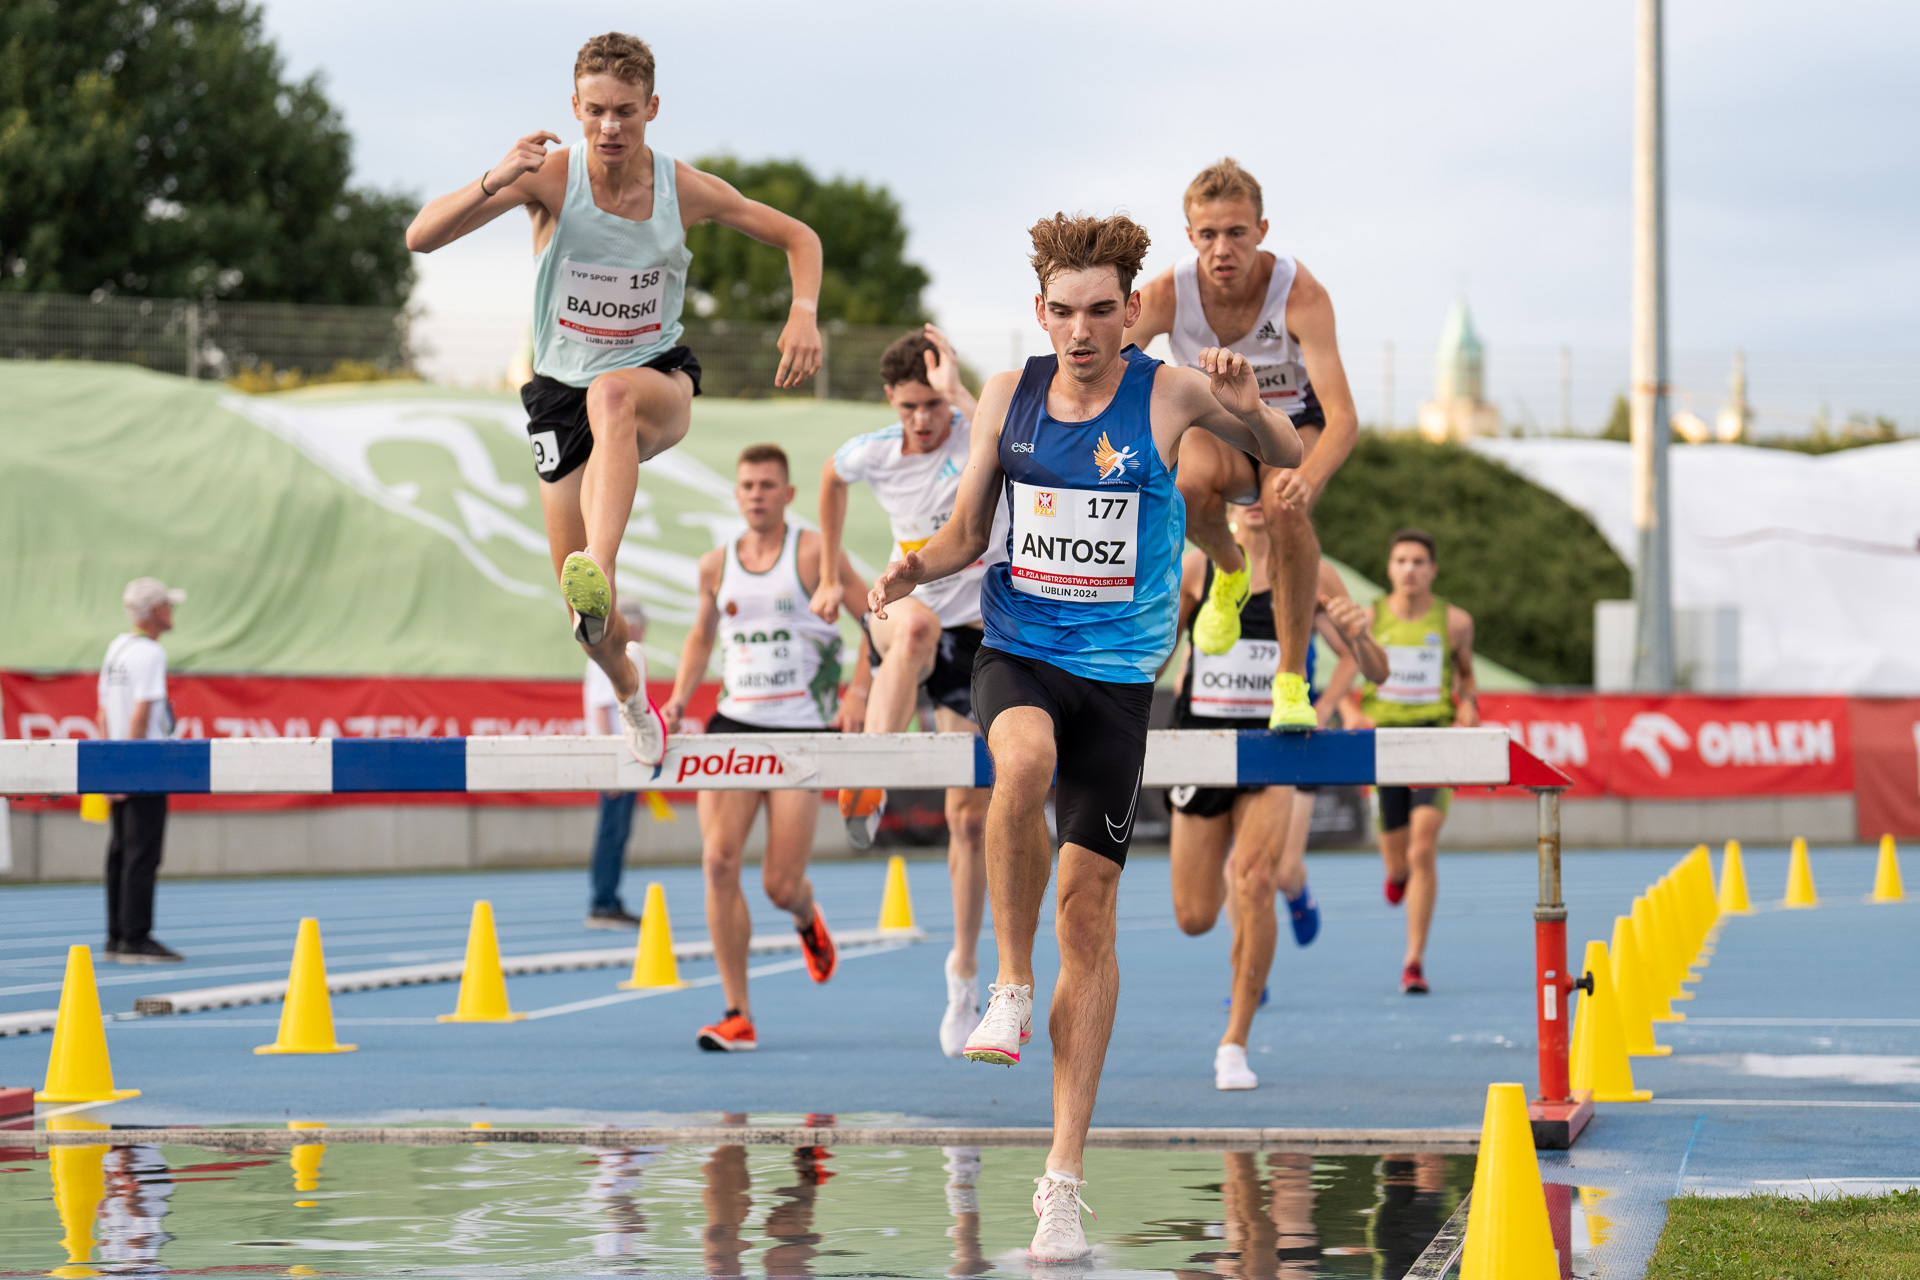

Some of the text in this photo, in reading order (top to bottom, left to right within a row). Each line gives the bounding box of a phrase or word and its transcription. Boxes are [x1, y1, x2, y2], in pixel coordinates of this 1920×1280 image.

[571, 270, 618, 282] TVP SPORT
[630, 270, 660, 289] 158
[567, 295, 657, 319] BAJORSKI
[586, 336, 634, 345] LUBLIN 2024
[1034, 508, 1055, 517] PZLA
[1088, 497, 1128, 519] 177
[1021, 532, 1126, 564] ANTOSZ
[1026, 571, 1039, 579] PZLA
[1040, 573, 1088, 585] MISTRZOSTWA
[1041, 585, 1098, 598] LUBLIN 2024
[1249, 644, 1277, 660] 379
[1698, 719, 1835, 767] ORLEN
